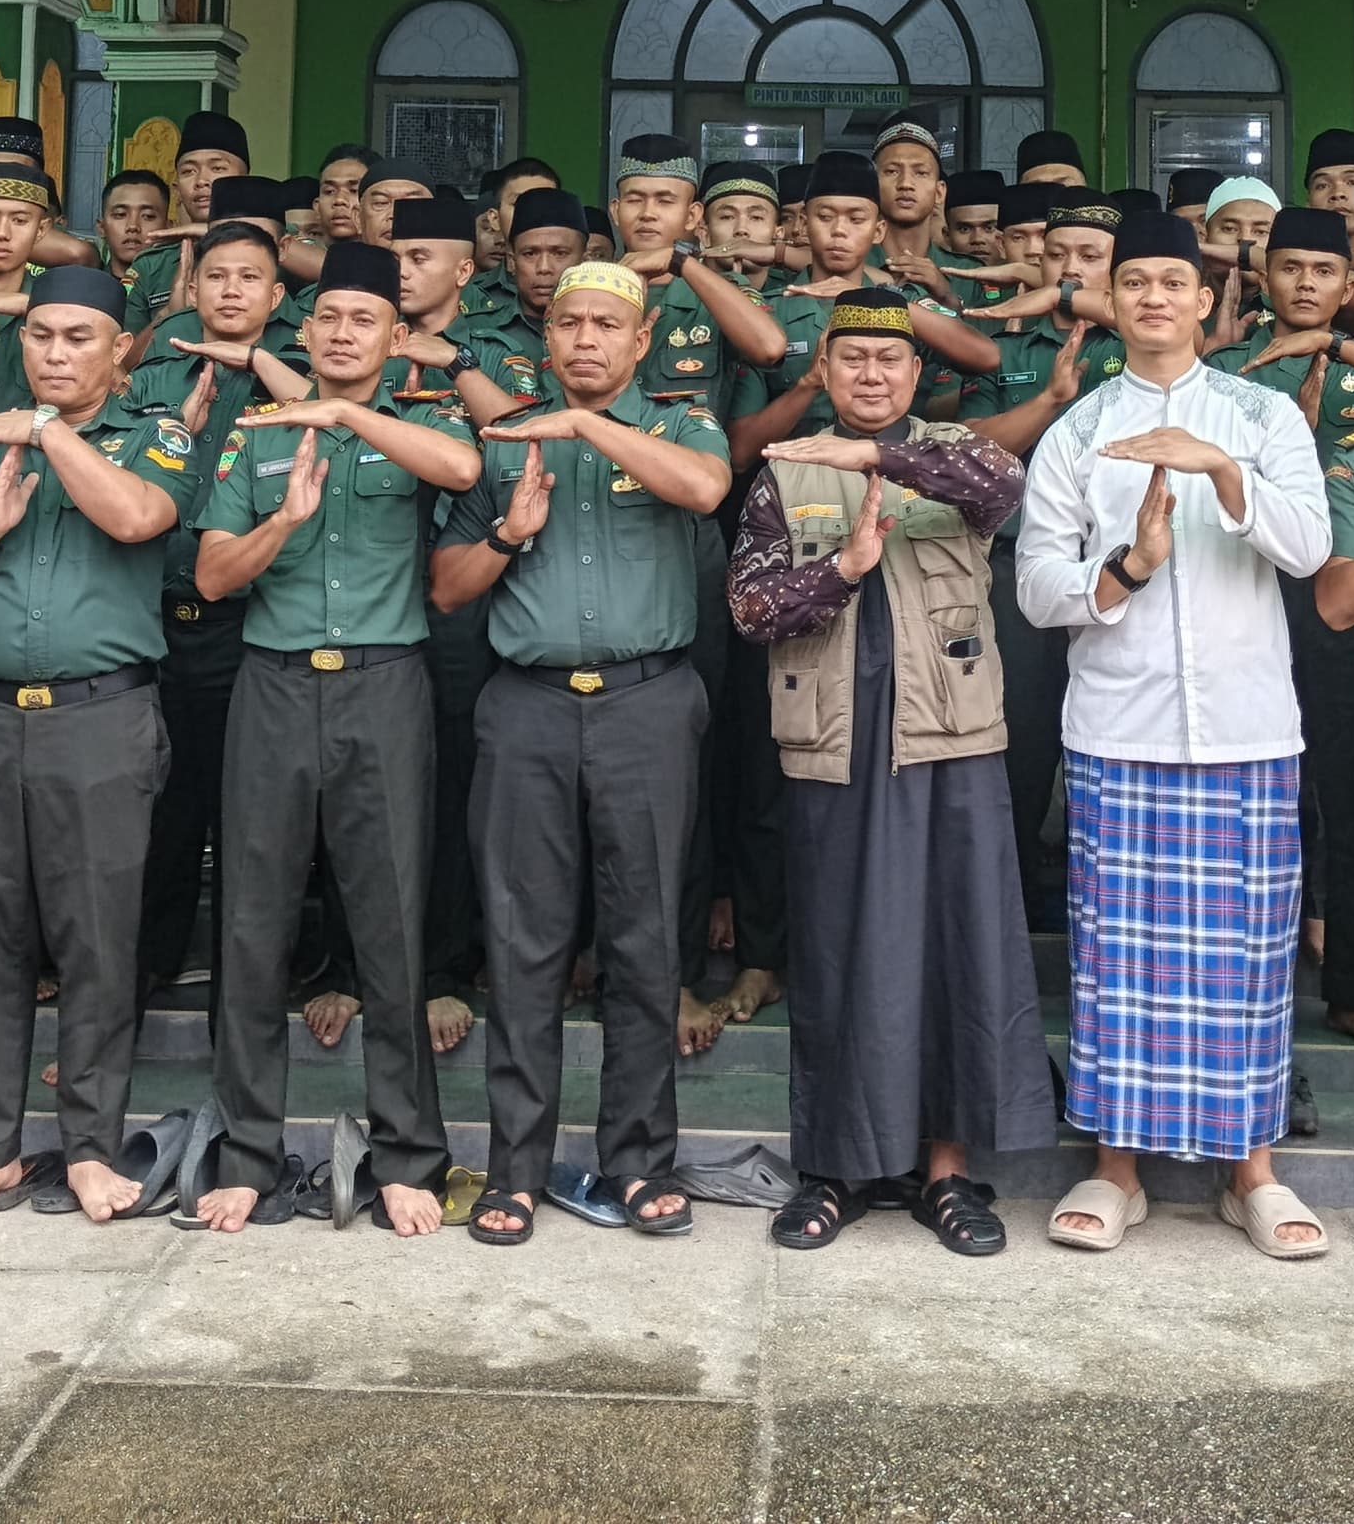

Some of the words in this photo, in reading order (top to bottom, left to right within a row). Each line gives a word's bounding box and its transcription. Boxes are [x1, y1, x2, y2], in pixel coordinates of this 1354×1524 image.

[754, 89, 789, 101] PINTU
[792, 90, 835, 103] MASUK
[838, 91, 863, 103] LAKI
[875, 91, 900, 104] LAKI
